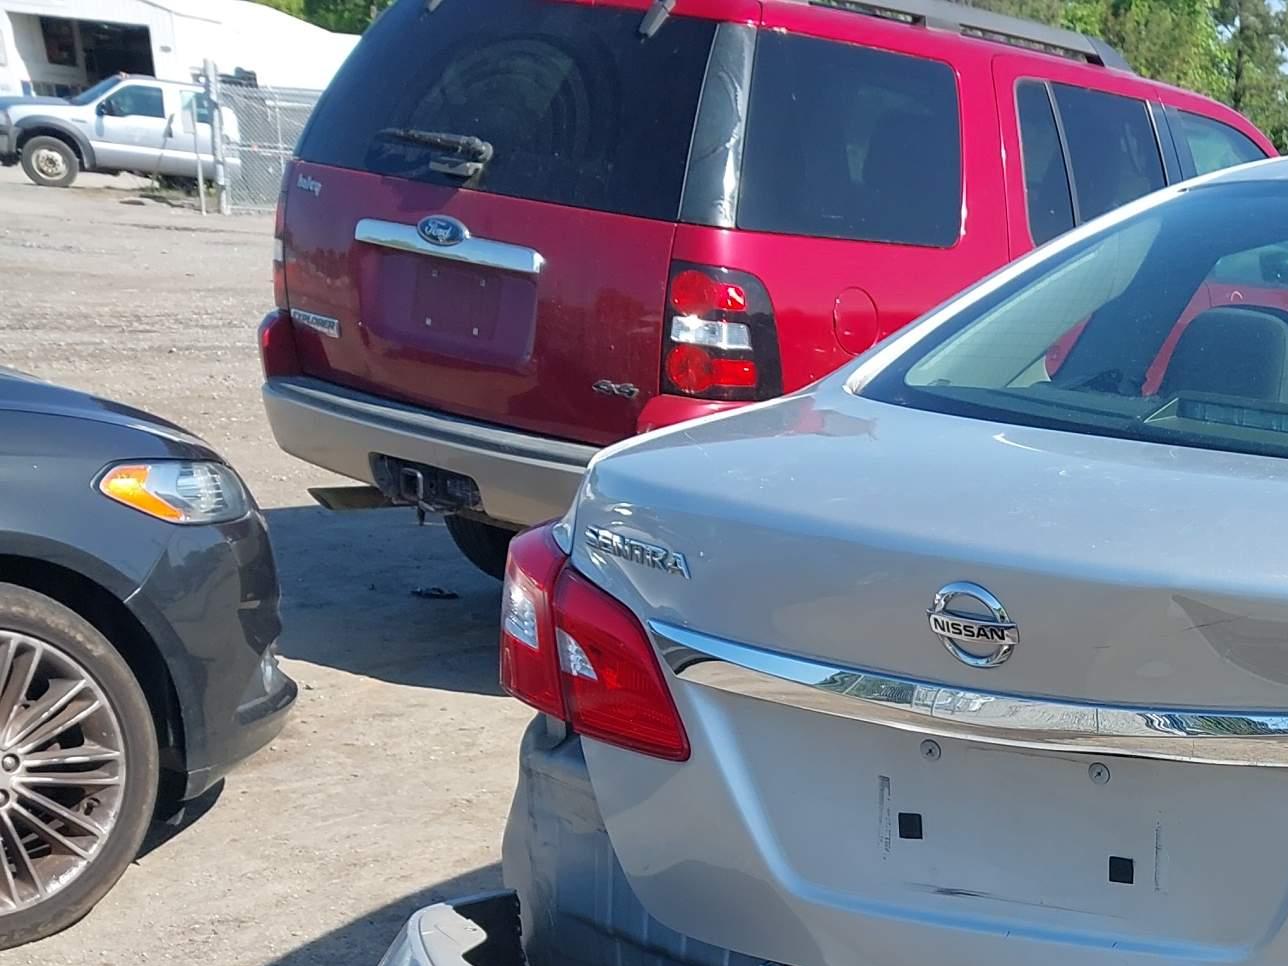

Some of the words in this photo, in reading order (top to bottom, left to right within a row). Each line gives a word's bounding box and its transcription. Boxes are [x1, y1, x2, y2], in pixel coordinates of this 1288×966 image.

[425, 220, 453, 242] Ford
[585, 525, 692, 580] SENTRA
[933, 617, 1006, 641] NISSAN
